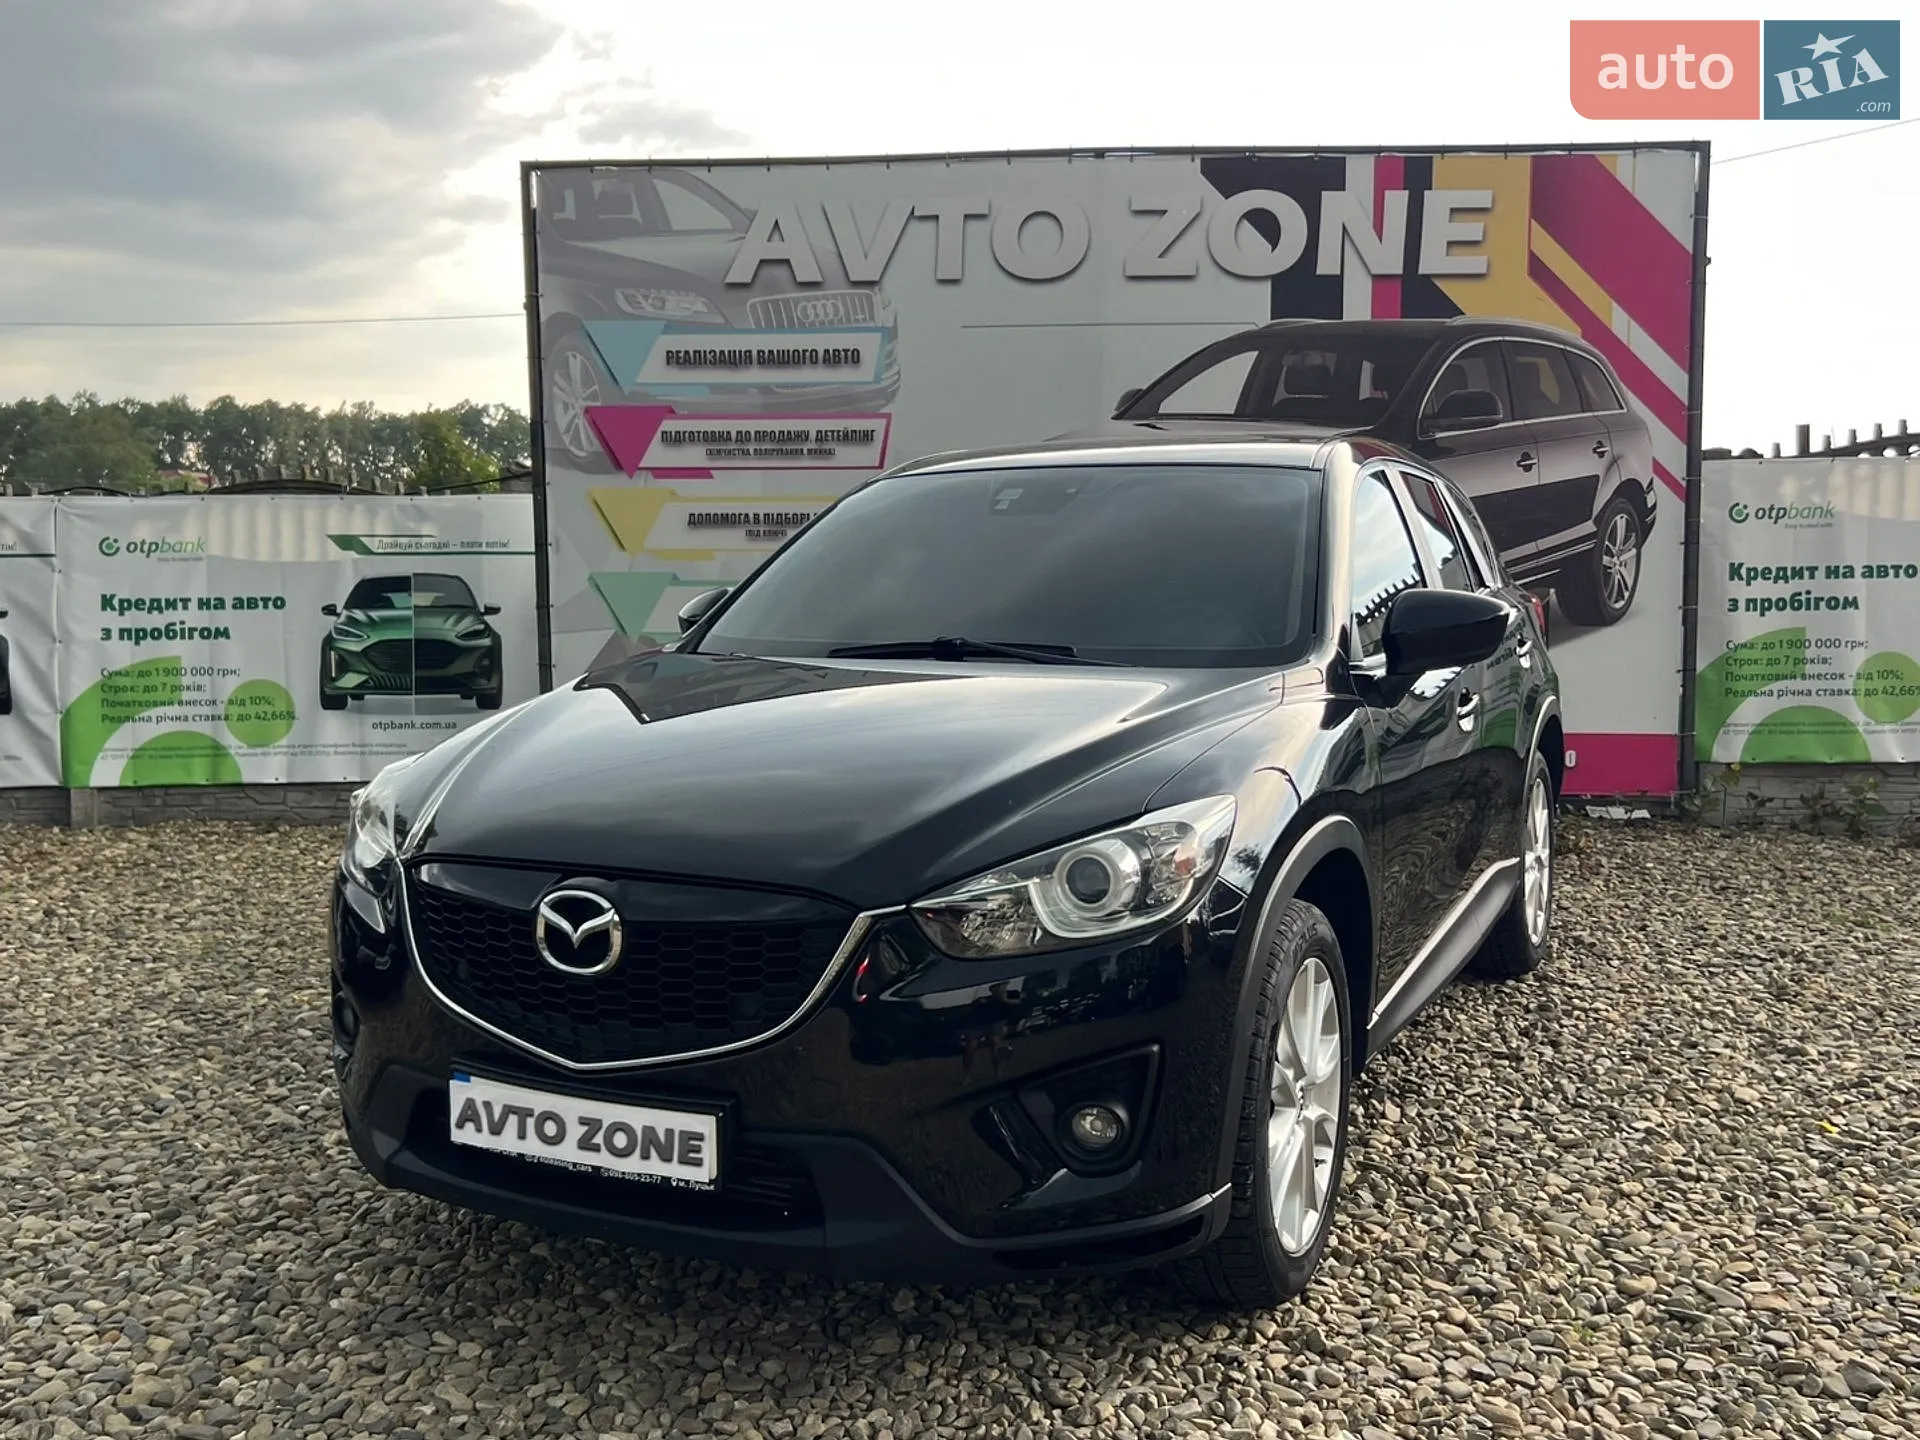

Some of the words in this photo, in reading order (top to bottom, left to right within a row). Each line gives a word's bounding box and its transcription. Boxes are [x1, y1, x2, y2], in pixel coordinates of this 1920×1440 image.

[724, 198, 1091, 285] AVTO
[1124, 189, 1495, 278] ZONE
[666, 349, 753, 366] РЕАЛІЗАЦІЯ
[756, 349, 818, 366] ВАШОГО
[821, 347, 861, 365] АВТО
[661, 430, 732, 444] ПІДГОТОВКА
[735, 430, 751, 444] ДО
[815, 428, 876, 443] ДЕТЕЙЛІНГ
[687, 512, 750, 527] ДОПОМОГА
[753, 512, 760, 525] В
[1754, 500, 1835, 524] otpbank
[126, 537, 205, 558] otpbank
[460, 540, 483, 549] плати
[1728, 562, 1819, 586] Кредит
[1825, 565, 1855, 579] на
[1861, 564, 1918, 579] авто
[101, 594, 191, 616] Кредит
[198, 597, 226, 610] на
[232, 596, 286, 610] авто
[1727, 598, 1739, 612] з
[1745, 590, 1859, 617] пробігом
[101, 627, 112, 641] з
[118, 620, 231, 646] пробігом
[1726, 640, 1758, 652] Сума:
[1761, 641, 1776, 651] до
[1815, 638, 1841, 649] 000
[1844, 640, 1868, 651] грн;
[1726, 656, 1763, 668] Строк:
[1765, 656, 1781, 667] до
[1784, 655, 1790, 665] 7
[1793, 654, 1833, 667] років;
[101, 668, 134, 680] Сума:
[137, 669, 152, 679] до
[190, 667, 214, 677] 000
[217, 668, 240, 679] грн;
[1725, 670, 1797, 683] Початковий
[1801, 672, 1845, 681] внесок
[1856, 670, 1873, 681] від
[1876, 669, 1904, 681] 10%;
[101, 683, 140, 695] Строк:
[142, 684, 158, 695] до
[161, 683, 167, 692] 7
[170, 682, 207, 693] років;
[1725, 687, 1774, 698] Реальна
[1776, 686, 1812, 699] річна
[1815, 687, 1860, 697] ставка:
[1863, 687, 1879, 697] до
[101, 697, 175, 709] Початковий
[178, 699, 218, 708] внесок
[228, 696, 247, 707] від
[249, 696, 275, 706] 10%;
[101, 713, 152, 725] Реальна
[156, 713, 189, 725] річна
[192, 713, 234, 723] ставка:
[236, 713, 252, 723] до
[371, 720, 457, 732] otpbank.com.ua
[455, 1097, 567, 1146] AVTO
[577, 1115, 705, 1166] ZONE
